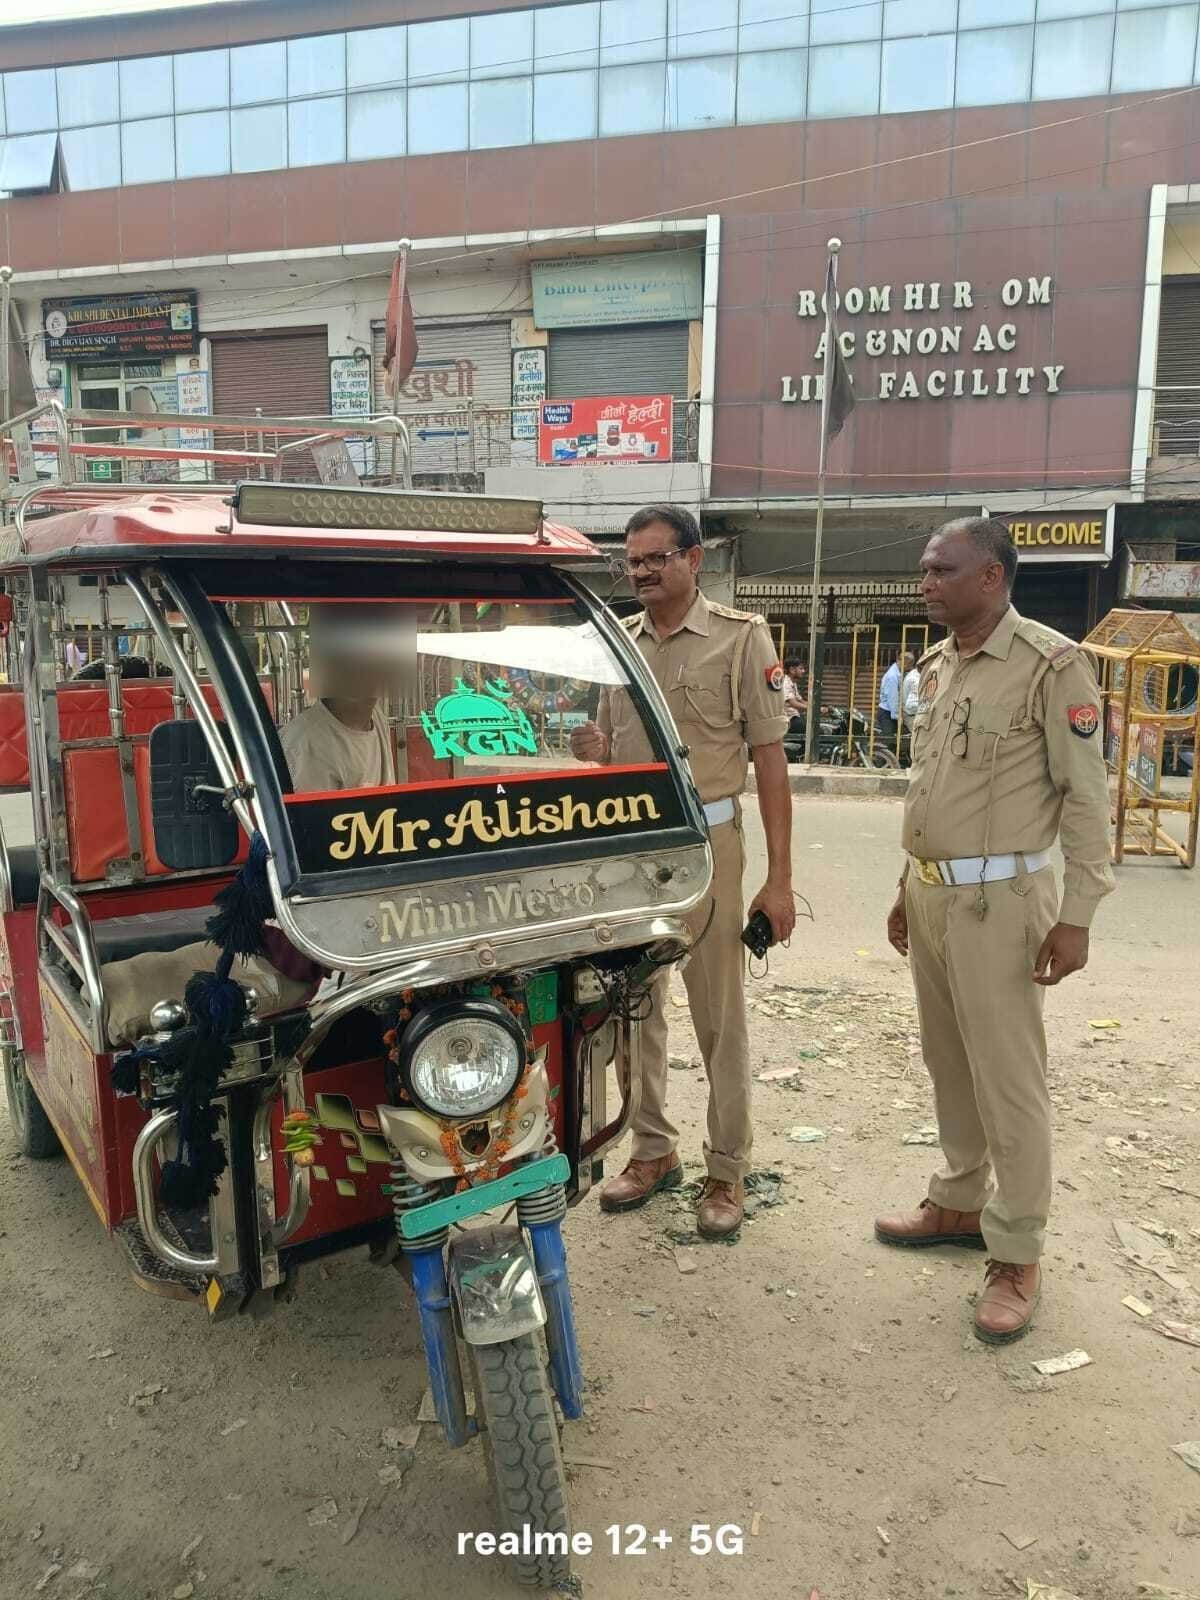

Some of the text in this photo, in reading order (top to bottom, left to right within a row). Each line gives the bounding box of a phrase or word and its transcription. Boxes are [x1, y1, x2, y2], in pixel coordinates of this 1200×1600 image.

[67, 308, 98, 322] KHUSHI
[99, 307, 131, 321] DENTAL
[62, 336, 94, 347] DIGVIJAY
[95, 335, 117, 346] SINGH
[973, 323, 1017, 352] AC
[879, 365, 1064, 399] FACILITY
[545, 405, 571, 414] Health
[547, 413, 569, 423] Ways
[433, 729, 538, 760] KGN
[379, 878, 596, 943] Mini Metro
